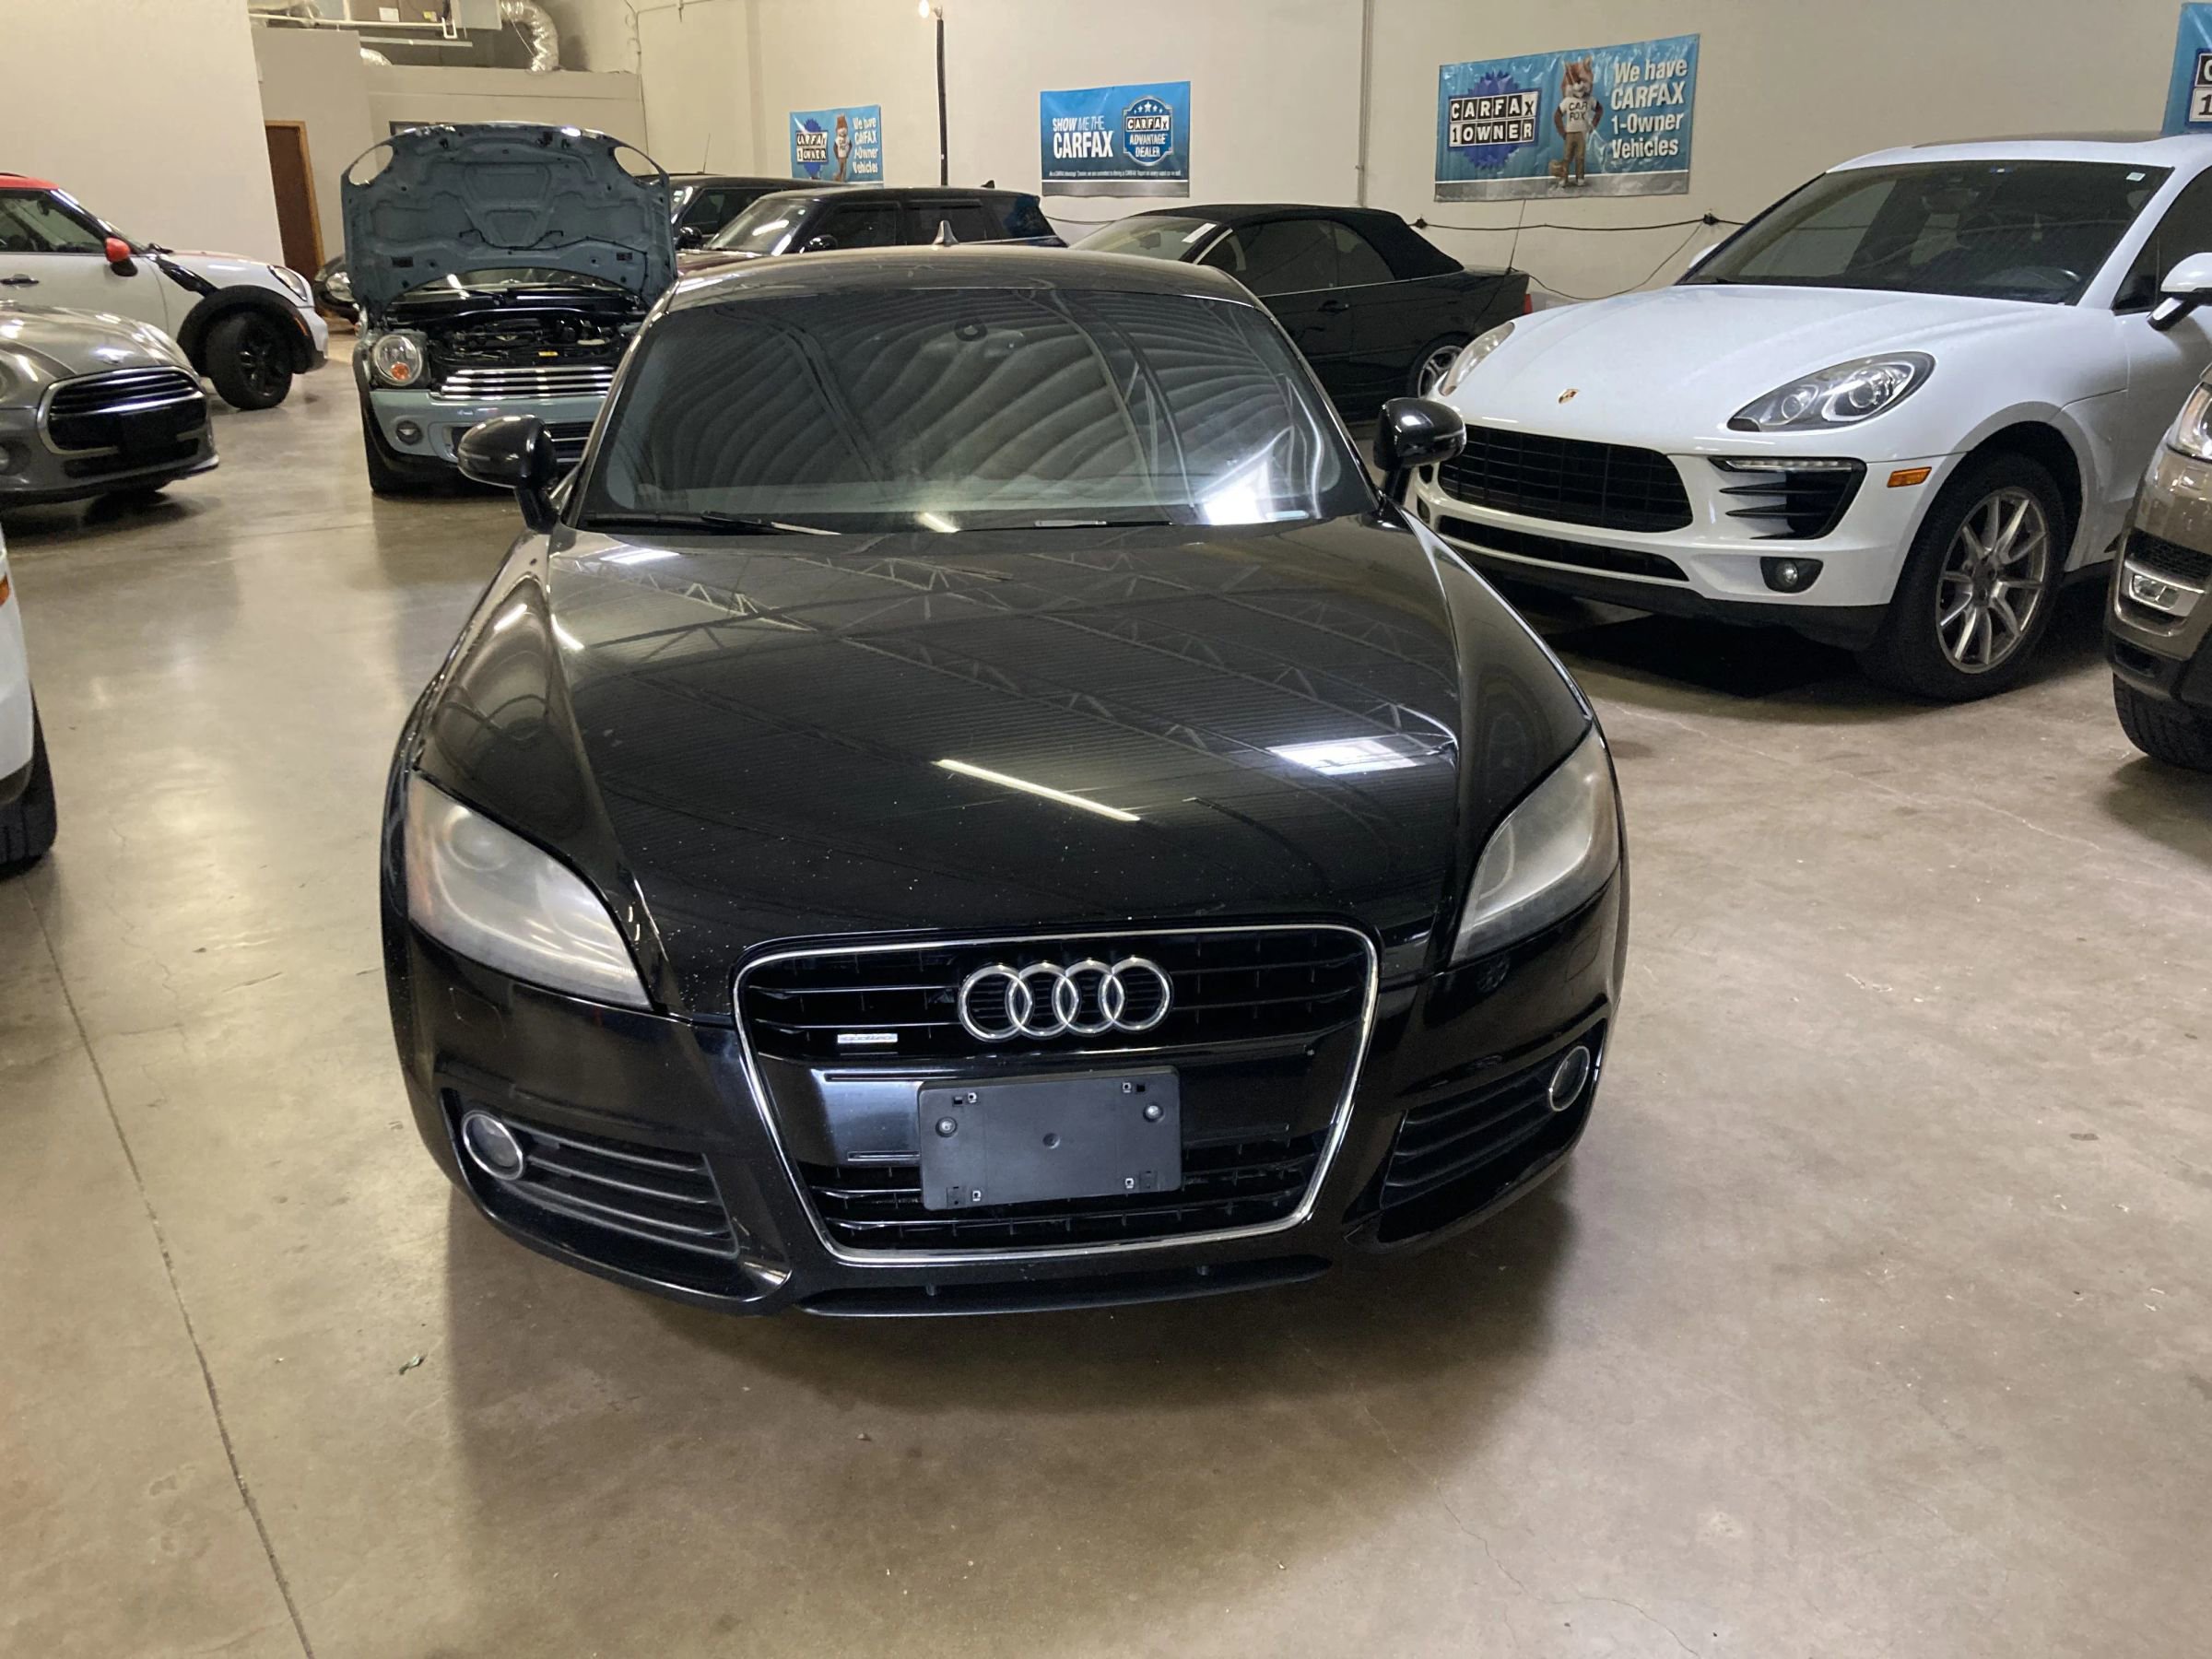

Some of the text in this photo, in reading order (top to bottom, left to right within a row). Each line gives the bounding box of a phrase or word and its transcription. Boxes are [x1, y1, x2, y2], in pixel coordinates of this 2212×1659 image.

[1615, 59, 1687, 84] We have
[1611, 82, 1684, 110] CARFAX
[1452, 97, 1534, 120] CARFAX
[1569, 102, 1587, 112] CAR
[1053, 115, 1104, 132] SHOW ME THE
[1127, 117, 1168, 130] CARFAX
[1463, 123, 1534, 142] OWNER
[1611, 113, 1684, 134] 1-Owner
[1053, 131, 1114, 159] CARFAX
[1130, 135, 1166, 145] ADVANTAGE
[1611, 138, 1678, 159] Vehicles
[1135, 147, 1160, 158] DEALER
